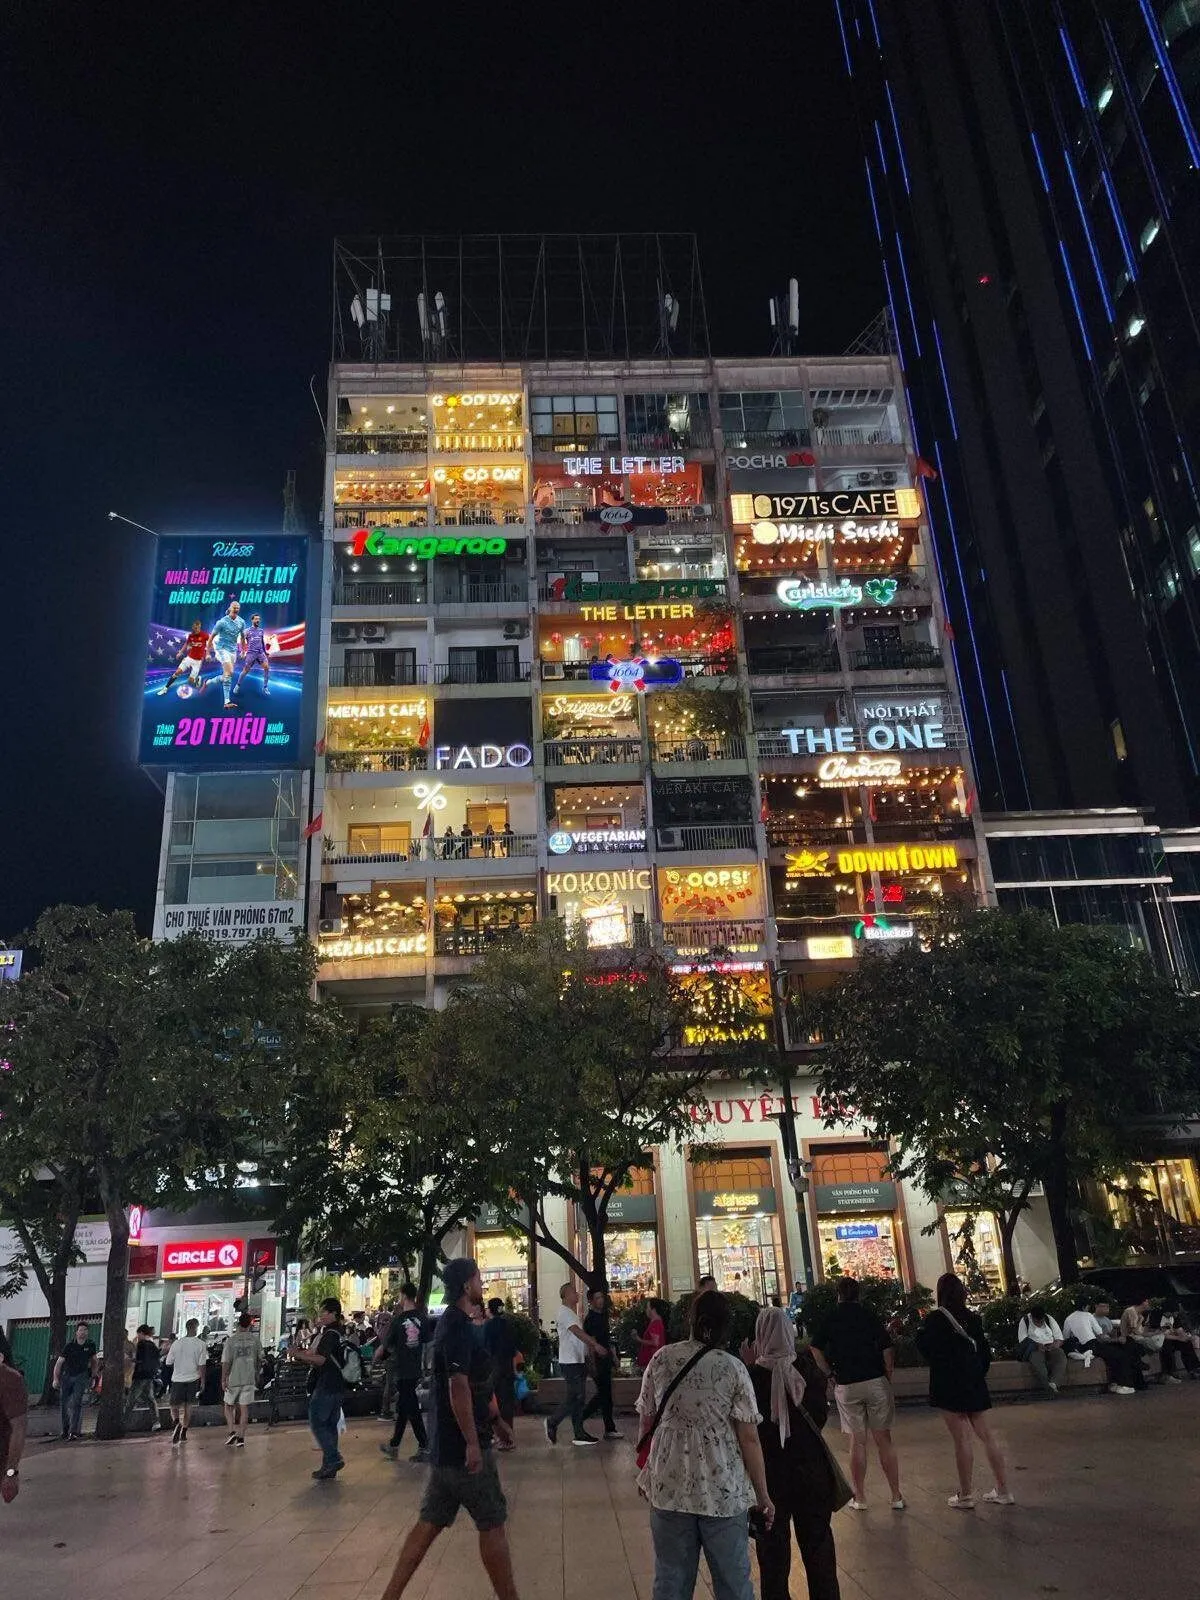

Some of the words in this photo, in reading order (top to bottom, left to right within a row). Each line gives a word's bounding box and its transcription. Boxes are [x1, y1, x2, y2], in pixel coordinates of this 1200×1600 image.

[488, 393, 520, 406] DAY
[564, 457, 602, 475] THE
[610, 456, 685, 474] LETTER
[726, 454, 787, 469] POCHA
[492, 467, 522, 481] DAY
[772, 495, 829, 516] 1971's
[832, 493, 898, 515] CAFE
[604, 511, 630, 520] 1664
[779, 522, 834, 543] Michi
[841, 520, 899, 540] Sushi
[352, 530, 508, 560] Kangaroo
[777, 578, 862, 610] Carlsberg
[581, 605, 617, 621] THE
[624, 604, 694, 620] LETTER
[612, 665, 640, 677] 1664
[328, 704, 386, 718] MERAKI
[549, 695, 608, 720] Saigon
[863, 704, 892, 720] NỘI
[896, 701, 937, 717] THẤT
[174, 717, 206, 746] 20
[209, 712, 267, 749] TRIỆU
[781, 727, 857, 753] THE
[868, 723, 947, 750] ONE
[436, 744, 532, 770] FADO
[572, 830, 646, 843] VEGETARIAN
[165, 911, 185, 928] CHO
[213, 907, 232, 926] VĂN
[267, 907, 294, 924] 67m2
[167, 1250, 216, 1265] CIRCLE
[222, 1248, 237, 1264] K
